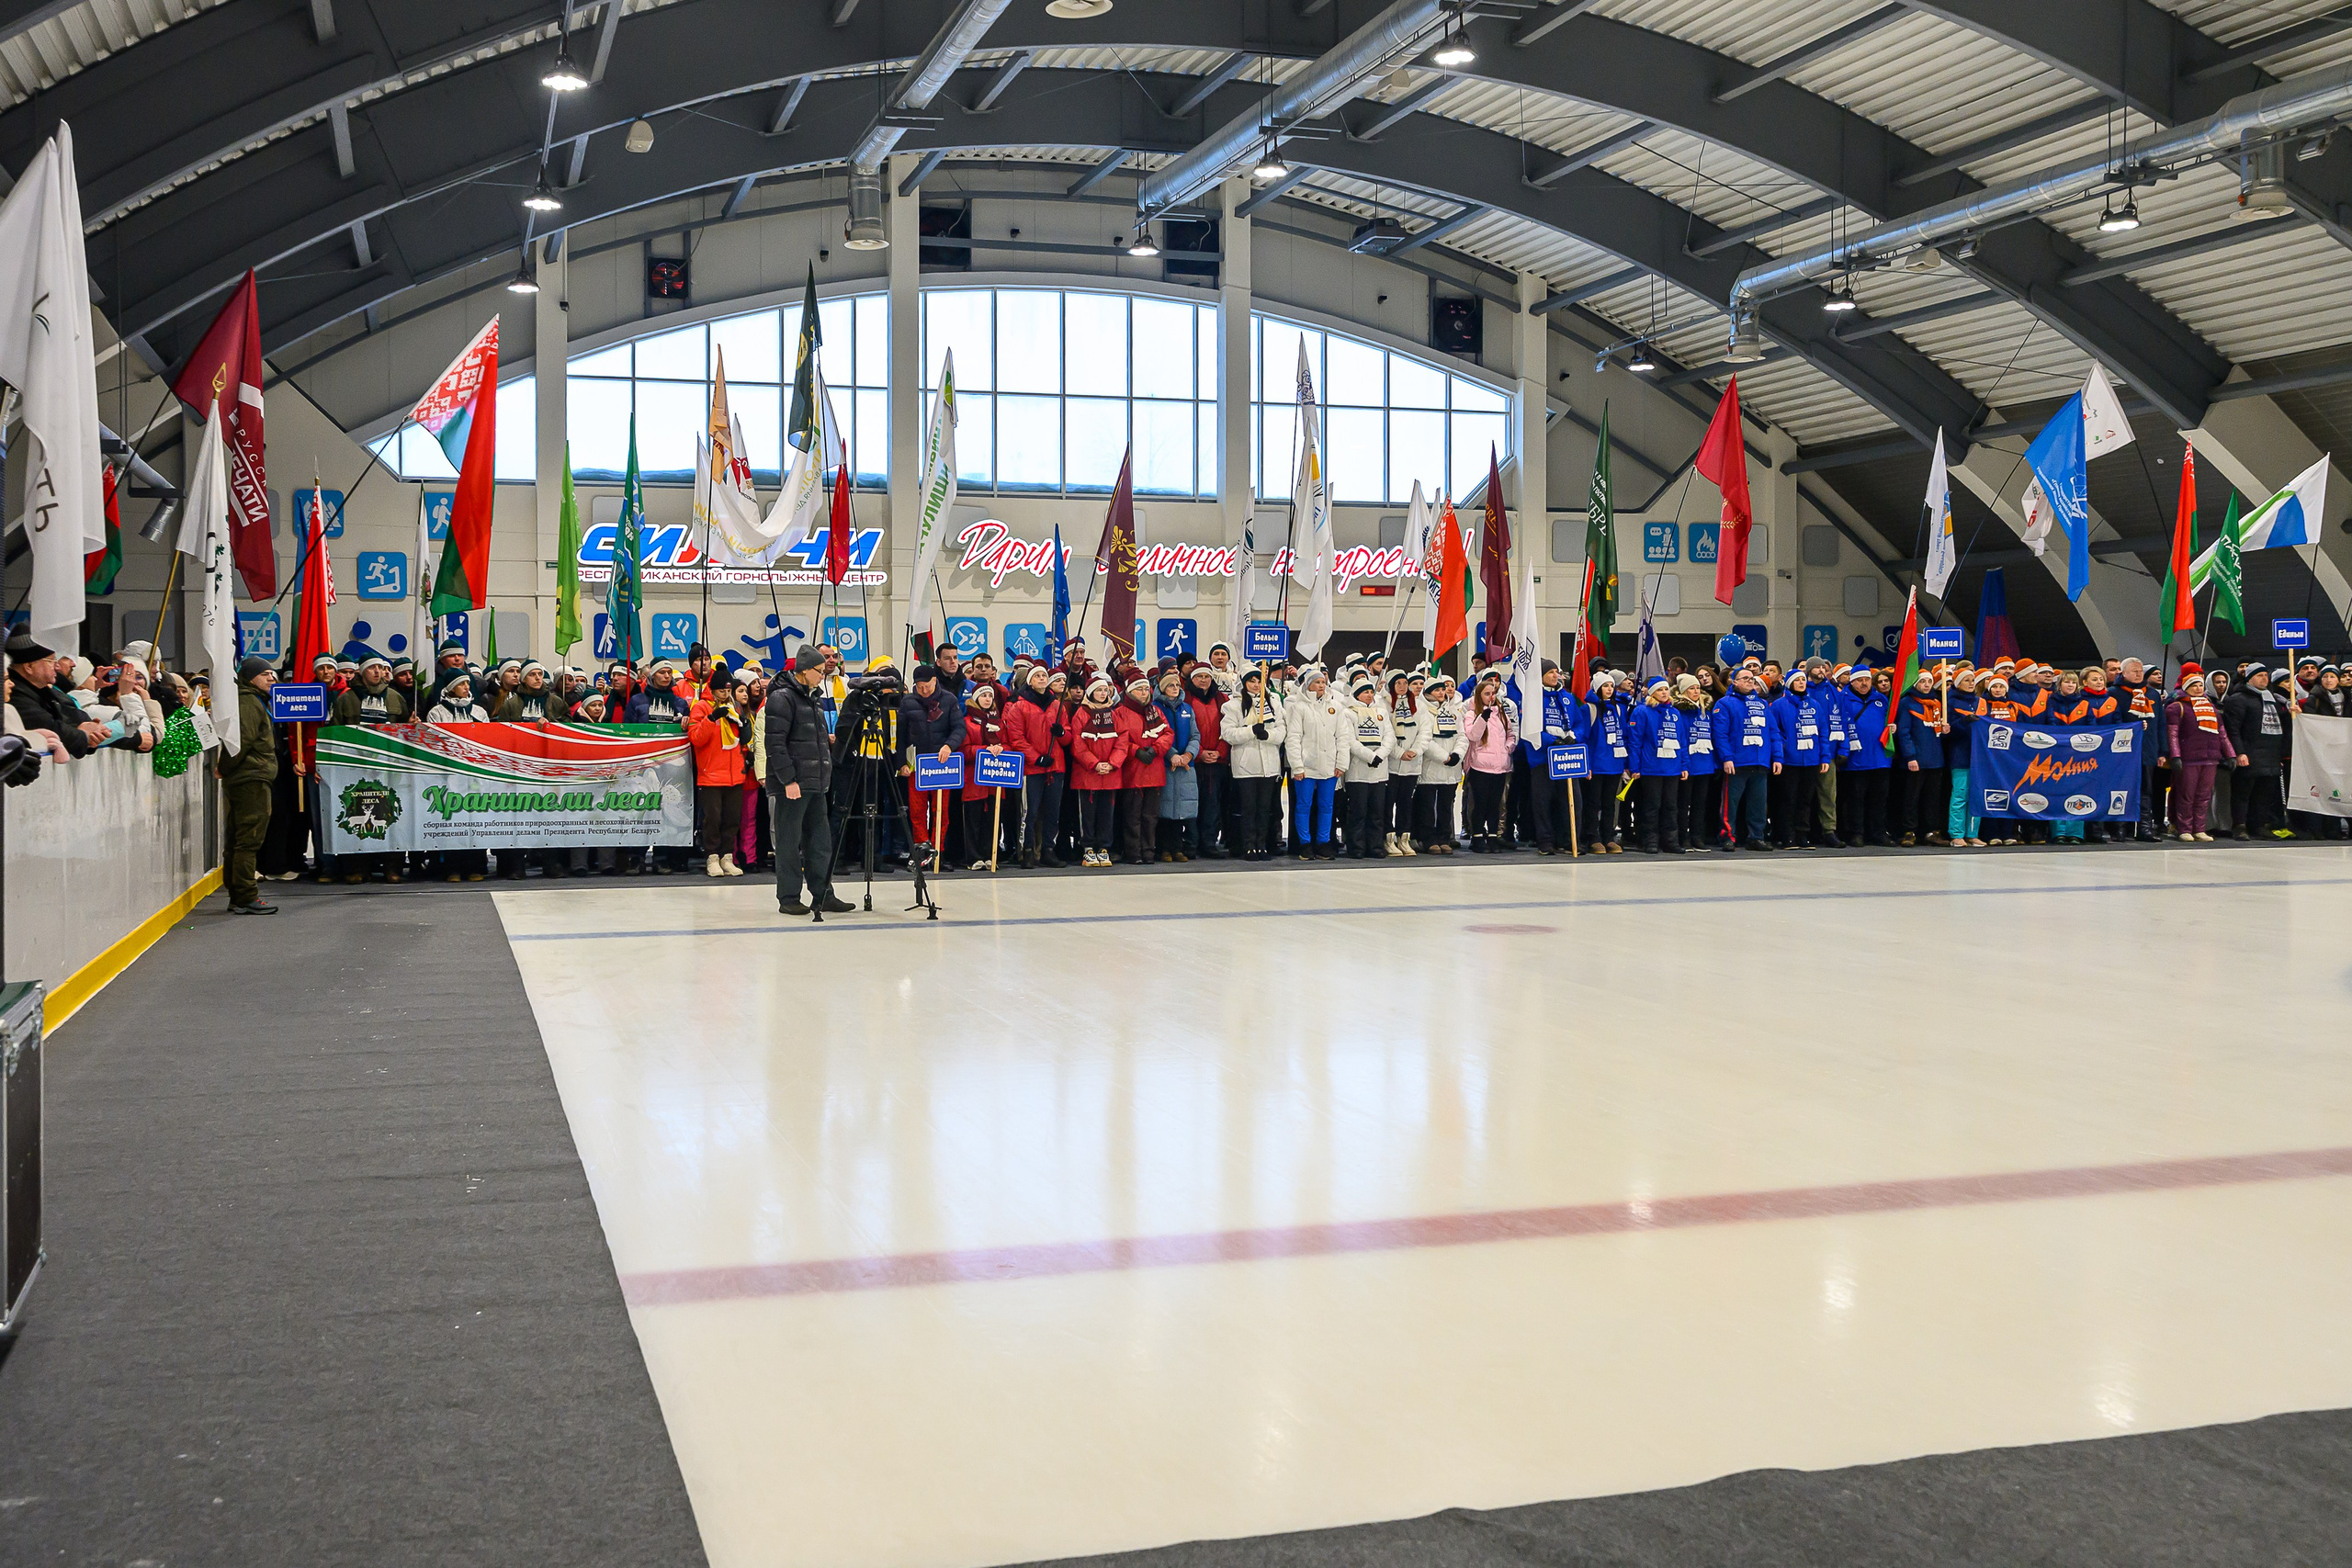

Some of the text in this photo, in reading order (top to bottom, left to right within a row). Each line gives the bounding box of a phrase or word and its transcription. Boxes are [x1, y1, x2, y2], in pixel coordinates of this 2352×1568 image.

[232, 448, 268, 523] ЕЧАТИ
[577, 569, 723, 582] РЕСПИКАНСКИЙ
[726, 571, 831, 582] ГОРНОЛЫЖНЫ
[968, 633, 985, 645] 24
[1255, 632, 1279, 641] Белые
[1253, 643, 1280, 653] тигры
[1929, 638, 1958, 648] Молния
[276, 694, 321, 705] Хранители
[289, 704, 308, 712] леса
[1554, 752, 1584, 761] Академия
[984, 758, 1011, 769] Моднае
[1557, 762, 1581, 772] сервиса
[982, 768, 1016, 779] народнае
[2012, 753, 2098, 795] Молния
[422, 784, 663, 821] Хранители леса
[423, 820, 452, 829] сборная
[484, 819, 525, 829] работников
[525, 819, 589, 829] природоохранных
[594, 818, 662, 827] лесохозяйственных
[423, 829, 469, 839] учреждений
[471, 829, 514, 838] Управления
[544, 829, 585, 837] Президента
[588, 828, 628, 836] Республики
[631, 827, 661, 836] Беларусь
